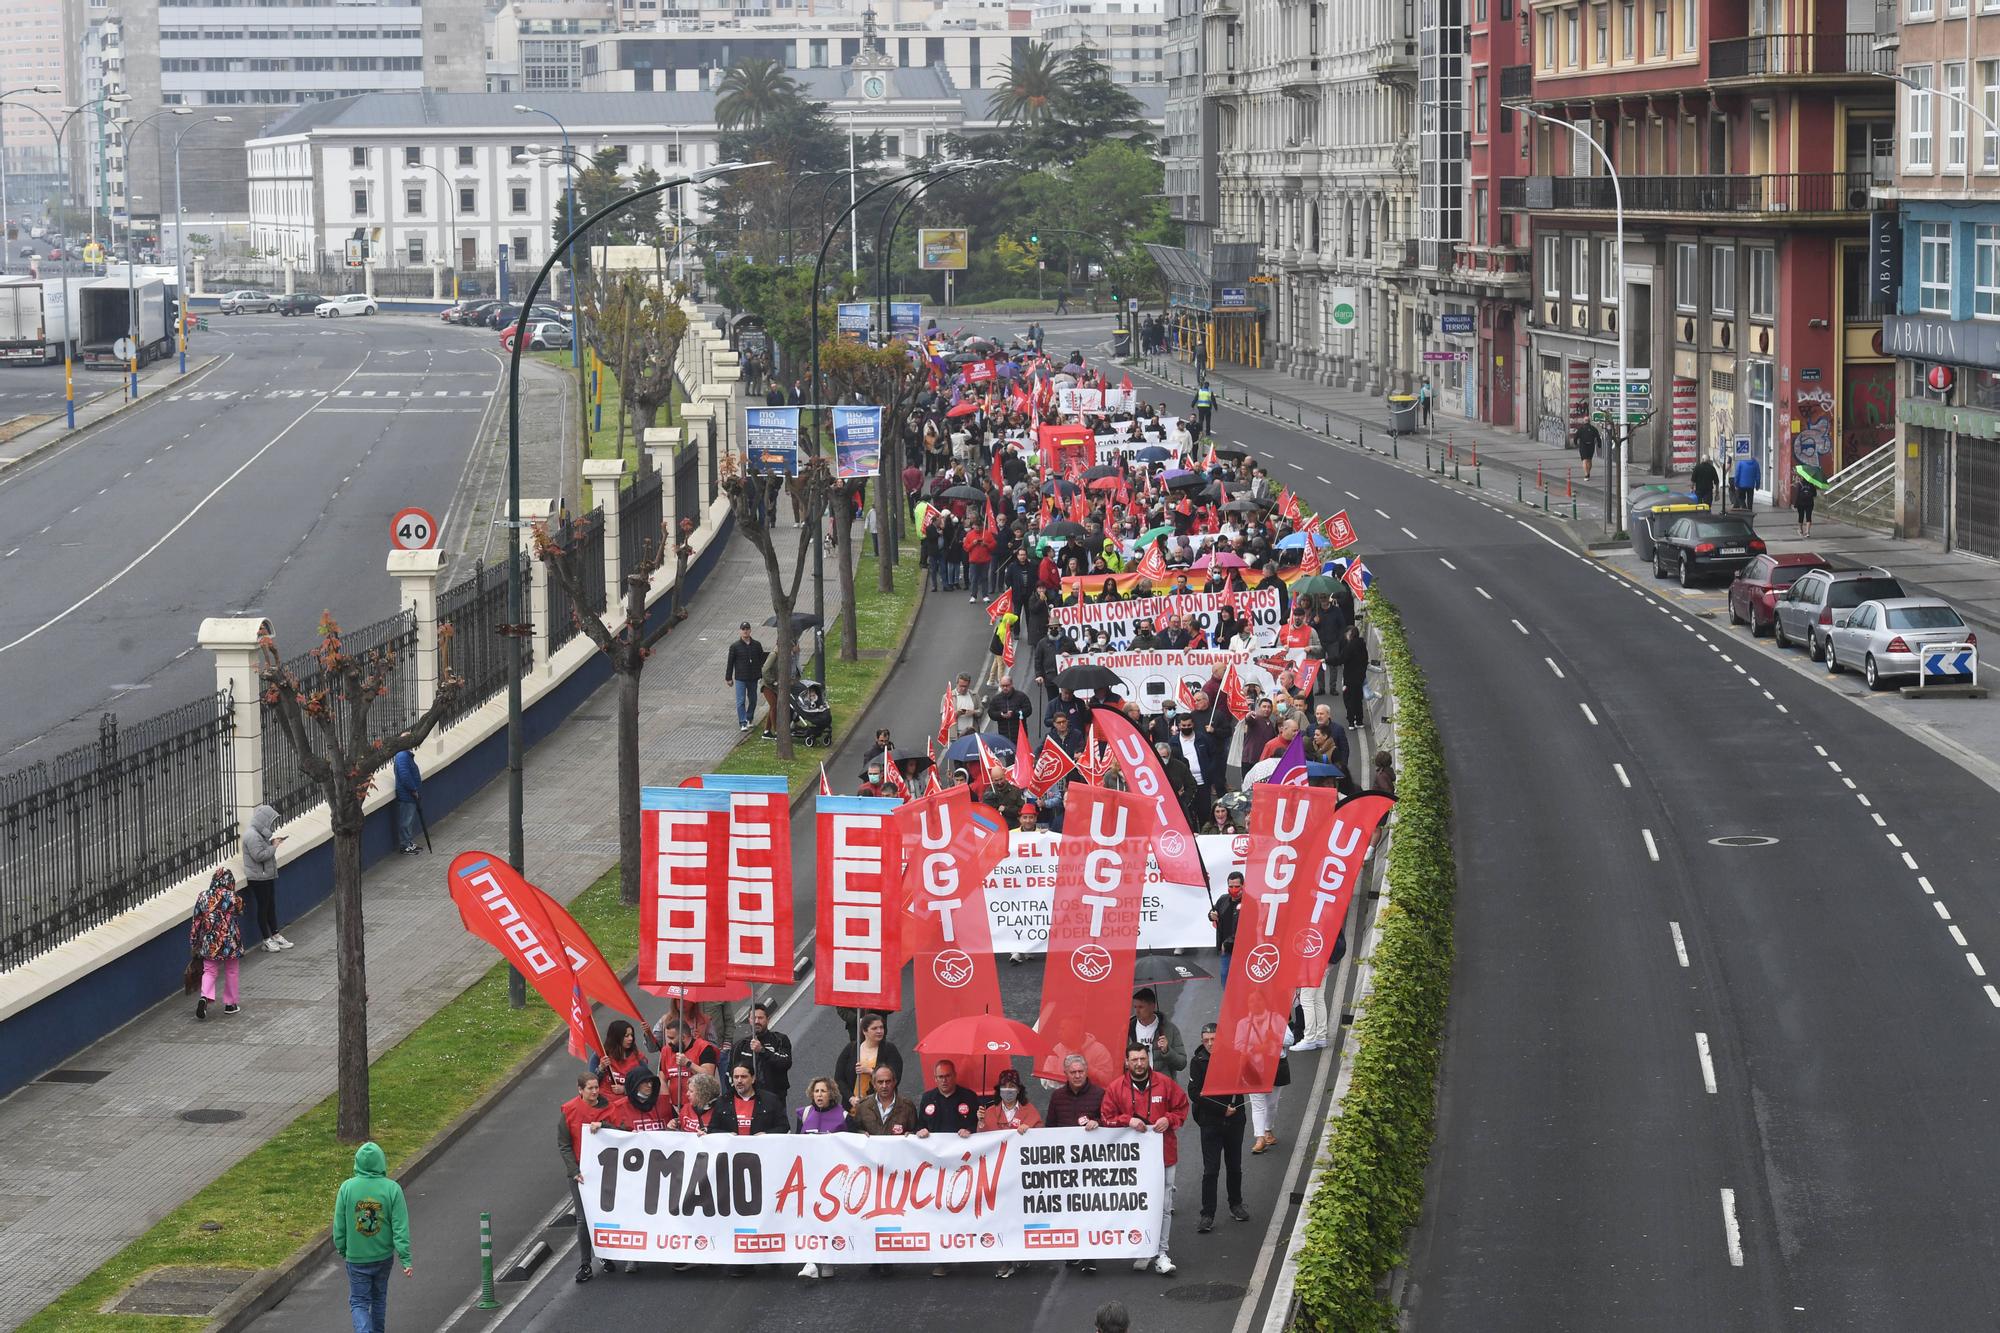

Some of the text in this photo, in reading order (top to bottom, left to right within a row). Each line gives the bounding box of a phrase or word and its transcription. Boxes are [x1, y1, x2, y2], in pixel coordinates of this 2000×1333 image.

[398, 523, 427, 539] 40
[1083, 601, 1102, 623] UN
[1106, 596, 1171, 621] CONVENIO
[1097, 653, 1163, 668] CONVENIO
[1167, 653, 1183, 666] PA
[1188, 652, 1250, 666] CUANDO?
[1018, 843, 1042, 857] EL
[919, 803, 962, 942] UGT
[1025, 865, 1045, 874] DEL
[1082, 802, 1128, 938] UGT
[1260, 798, 1310, 936] UGT
[1310, 819, 1361, 924] UGT
[728, 794, 775, 966] CCOO
[1003, 877, 1021, 888] EL
[656, 811, 708, 983] CCOO
[833, 815, 882, 993] CCOO
[990, 901, 1048, 913] CONTRA
[470, 871, 557, 974] CCOO
[997, 912, 1071, 926] PLANTILLA
[1014, 929, 1023, 940] Y
[1027, 928, 1058, 940] CON
[1019, 1143, 1140, 1165] SUBIR SALARIOS
[644, 1149, 762, 1217] MAIO
[775, 1155, 807, 1218] A
[813, 1140, 1008, 1222] SOLUCIÓN
[1021, 1167, 1138, 1189] CONTER PREZOS
[1023, 1191, 1148, 1213] MÁIS IGUALDADE
[596, 1230, 1124, 1250] CCOO UGT CCOO UGT CCOO UGT CCOO UGT
